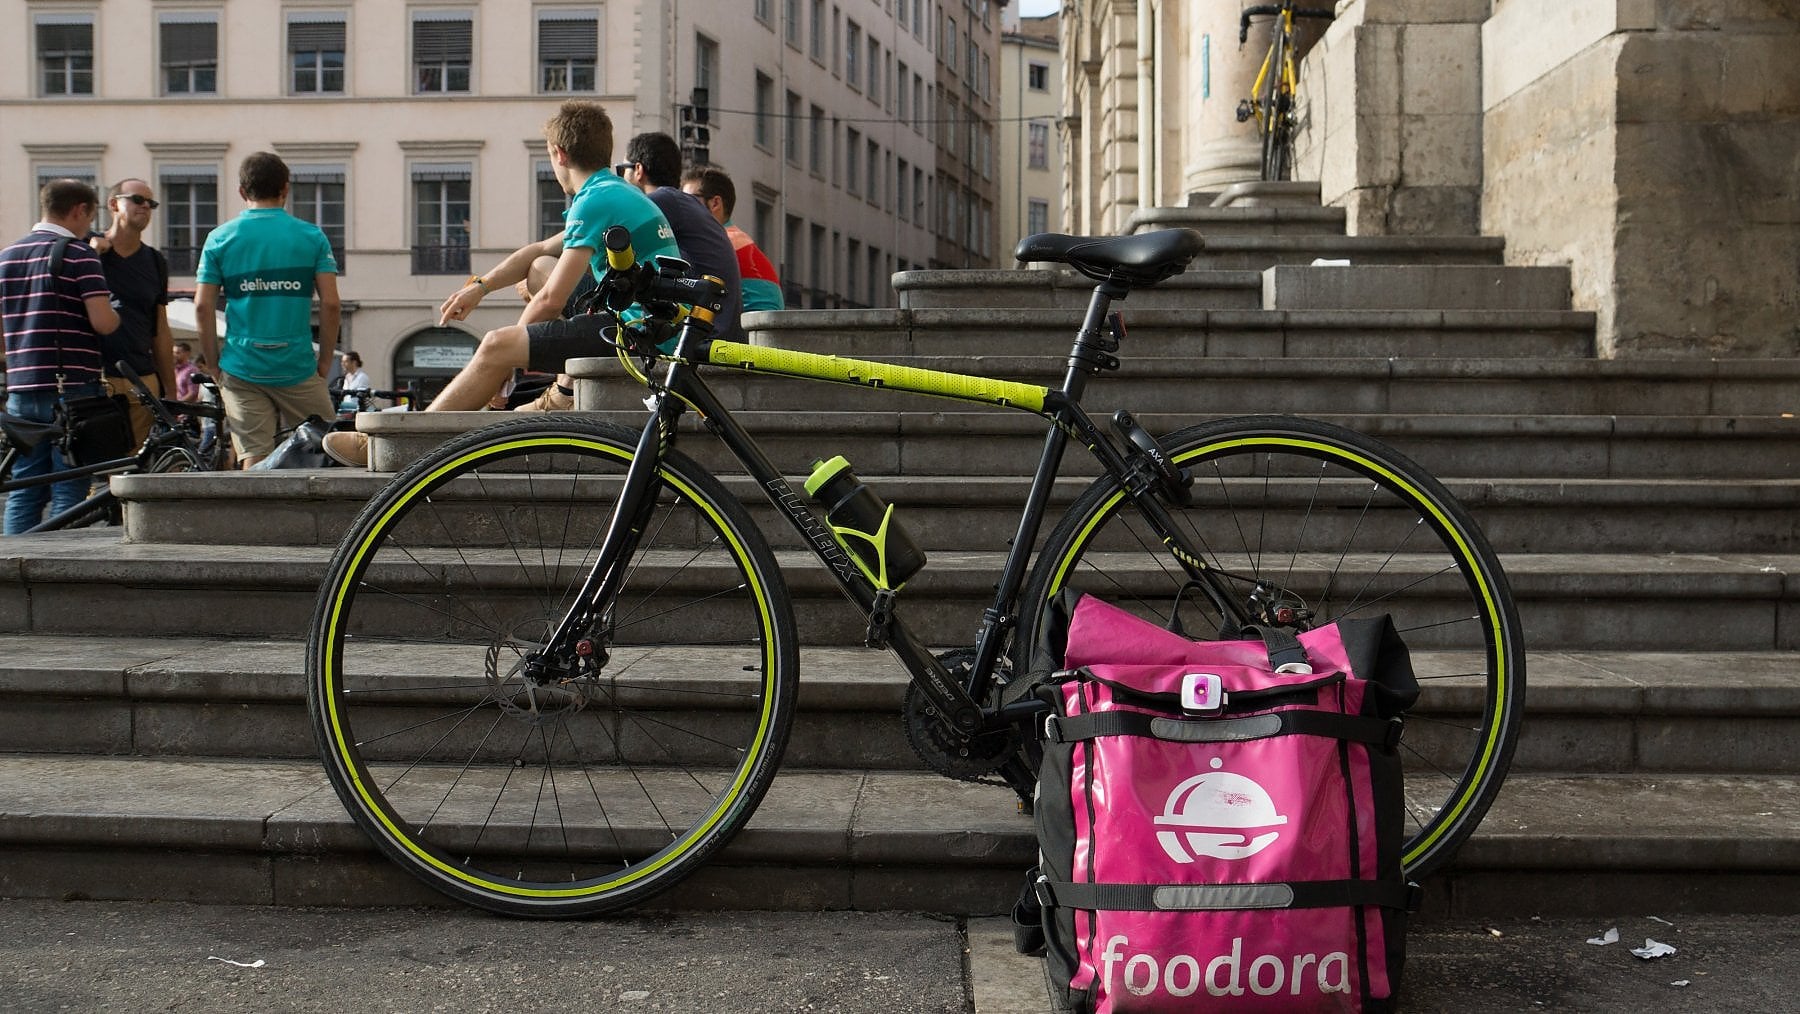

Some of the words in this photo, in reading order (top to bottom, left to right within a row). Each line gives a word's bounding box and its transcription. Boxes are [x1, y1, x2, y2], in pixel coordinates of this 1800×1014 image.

[240, 278, 302, 292] deliveroo
[1148, 448, 1164, 466] AXA
[1101, 934, 1352, 997] foodora
